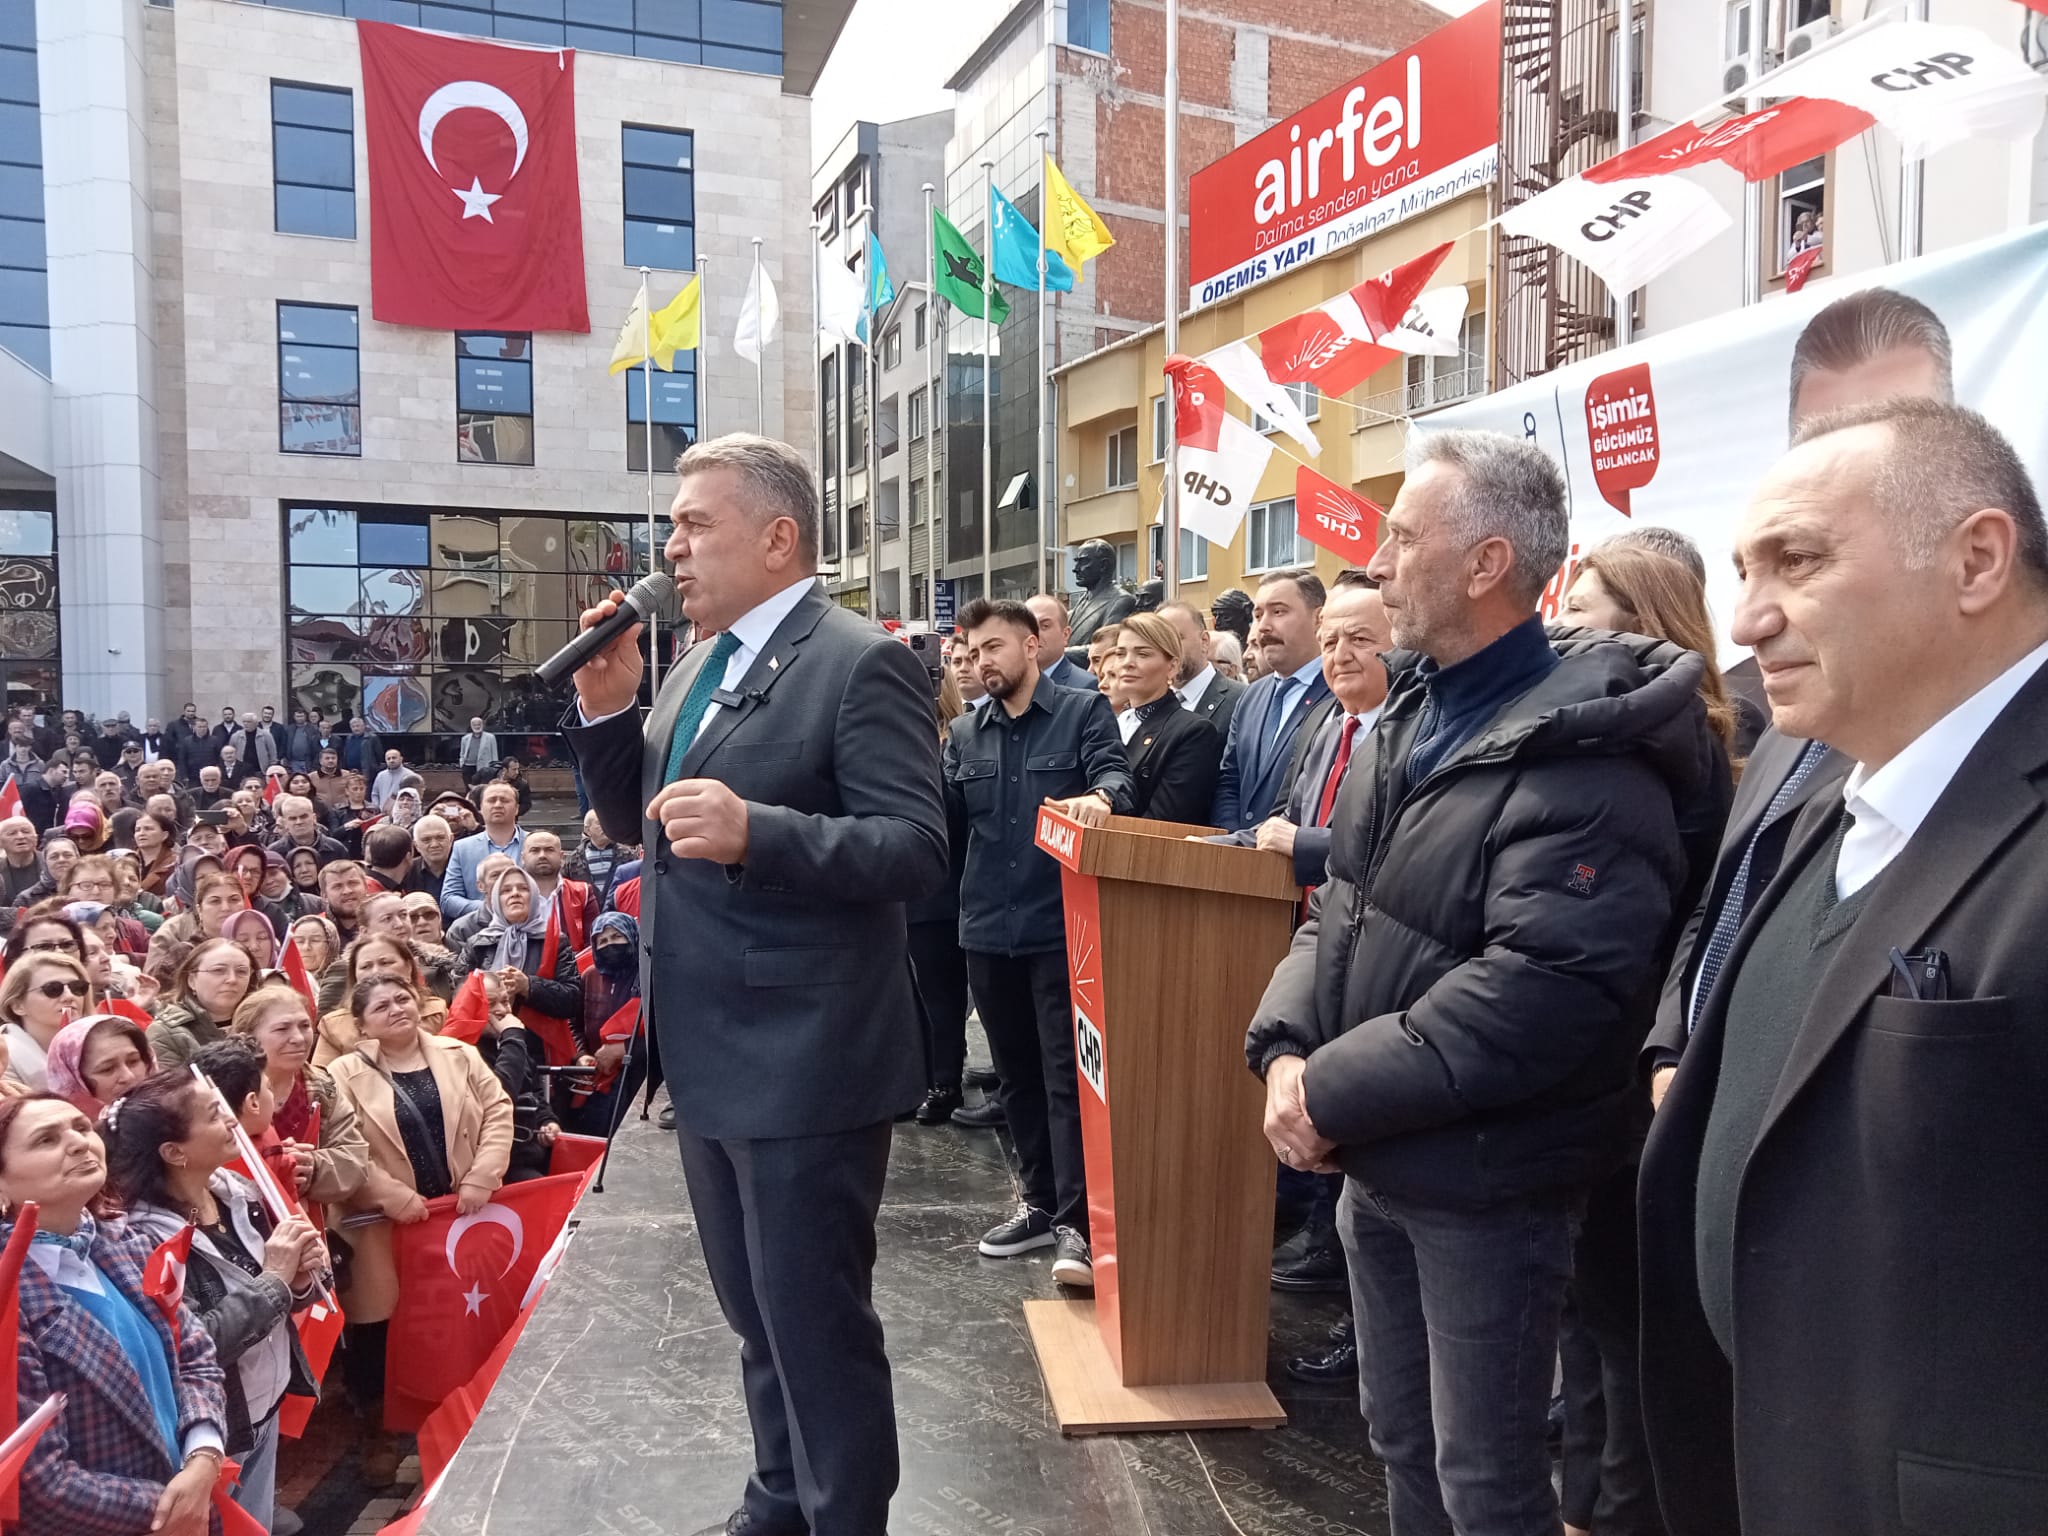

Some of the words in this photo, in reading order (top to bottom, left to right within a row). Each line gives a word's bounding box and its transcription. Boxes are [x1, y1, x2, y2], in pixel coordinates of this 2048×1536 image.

[1870, 51, 1975, 92] CHP
[1253, 54, 1422, 225] airfel
[1255, 219, 1304, 251] Daima
[1308, 186, 1367, 225] senden
[1371, 159, 1420, 200] yana
[1580, 189, 1653, 242] CHP
[1273, 237, 1315, 270] YAPI
[1588, 386, 1652, 430] işimiz
[1593, 427, 1654, 453] GÜCÜMÜZ
[1595, 447, 1656, 471] BULANCAK
[1040, 815, 1077, 860] BULANCAK
[1077, 1016, 1102, 1085] CHP
